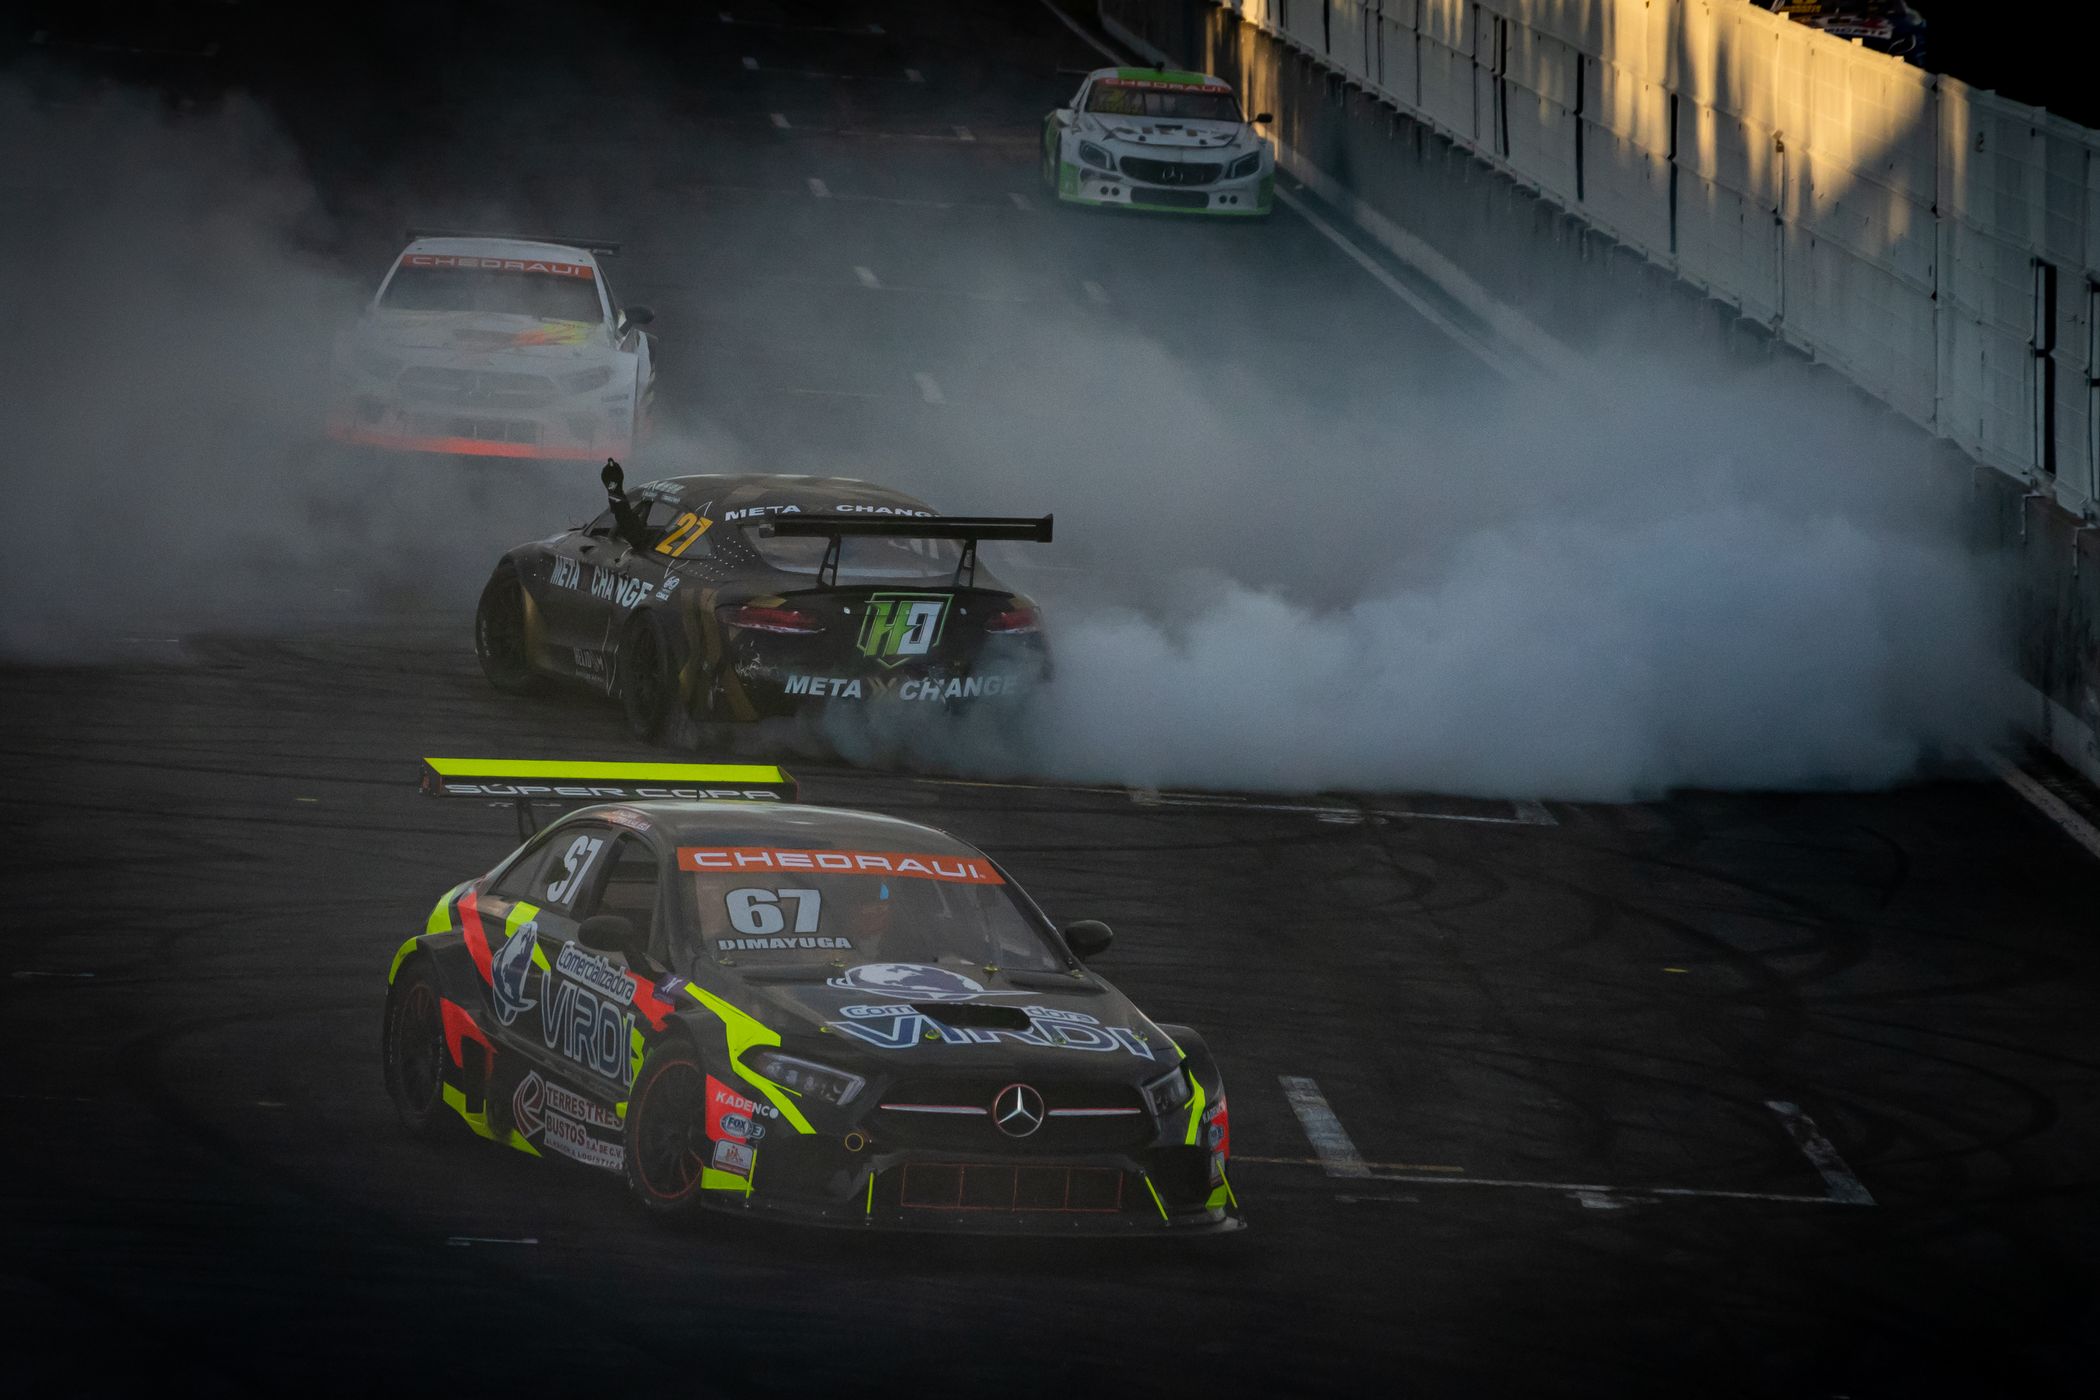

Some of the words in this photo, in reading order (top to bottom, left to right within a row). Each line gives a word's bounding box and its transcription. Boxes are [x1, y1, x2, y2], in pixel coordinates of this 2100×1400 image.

[411, 256, 580, 277] CHEDRAUI
[724, 504, 801, 521] META
[835, 503, 943, 518] CHANG
[550, 555, 581, 590] META
[784, 675, 862, 698] META
[899, 674, 1017, 702] CHANGE
[635, 787, 783, 800] COPA
[692, 850, 979, 879] CHEDRAUI
[725, 886, 823, 935] 67
[717, 936, 853, 951] DIMAYUGA
[557, 941, 637, 1005] Comercializadora
[541, 970, 636, 1088] VIRDI
[546, 1114, 586, 1147] BUSTOS
[727, 1117, 746, 1131] FOX
